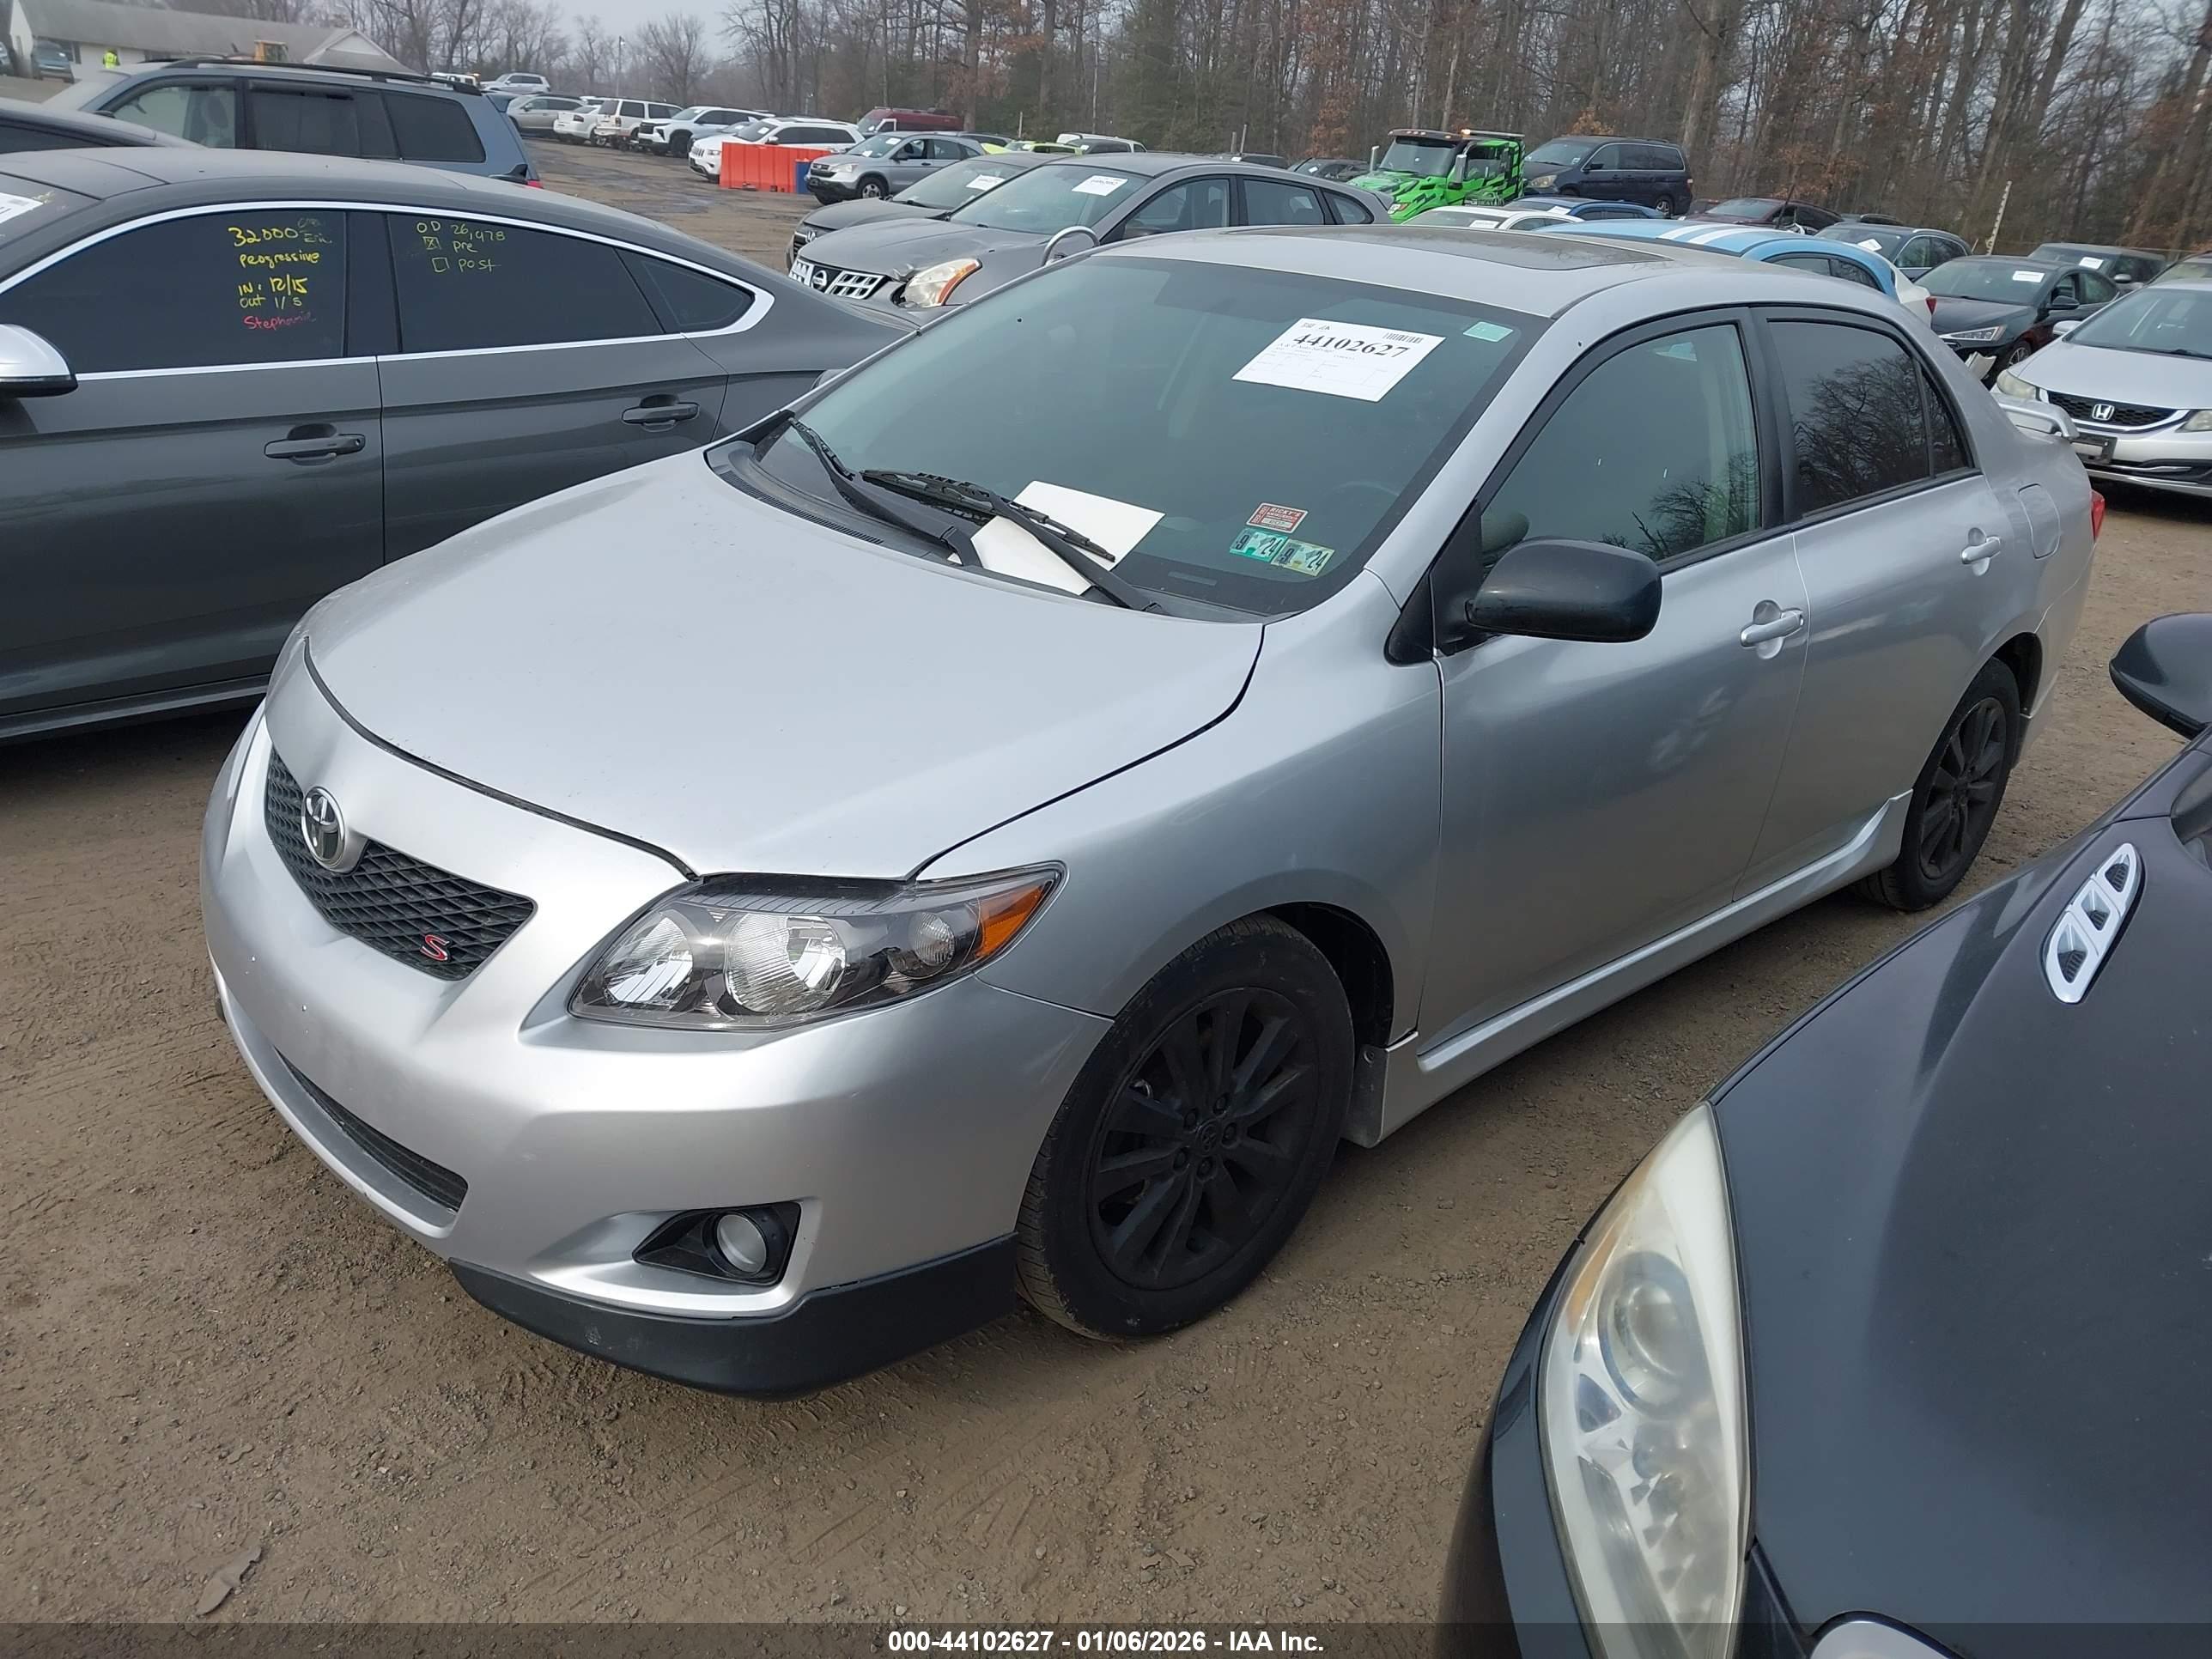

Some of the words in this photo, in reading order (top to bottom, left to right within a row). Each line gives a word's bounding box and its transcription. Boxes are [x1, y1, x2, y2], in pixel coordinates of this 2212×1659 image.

[269, 274, 308, 296] 12/15
[1292, 333, 1409, 358] 44102627
[1261, 537, 1283, 557] 24
[1307, 550, 1329, 571] 24
[420, 934, 450, 961] S
